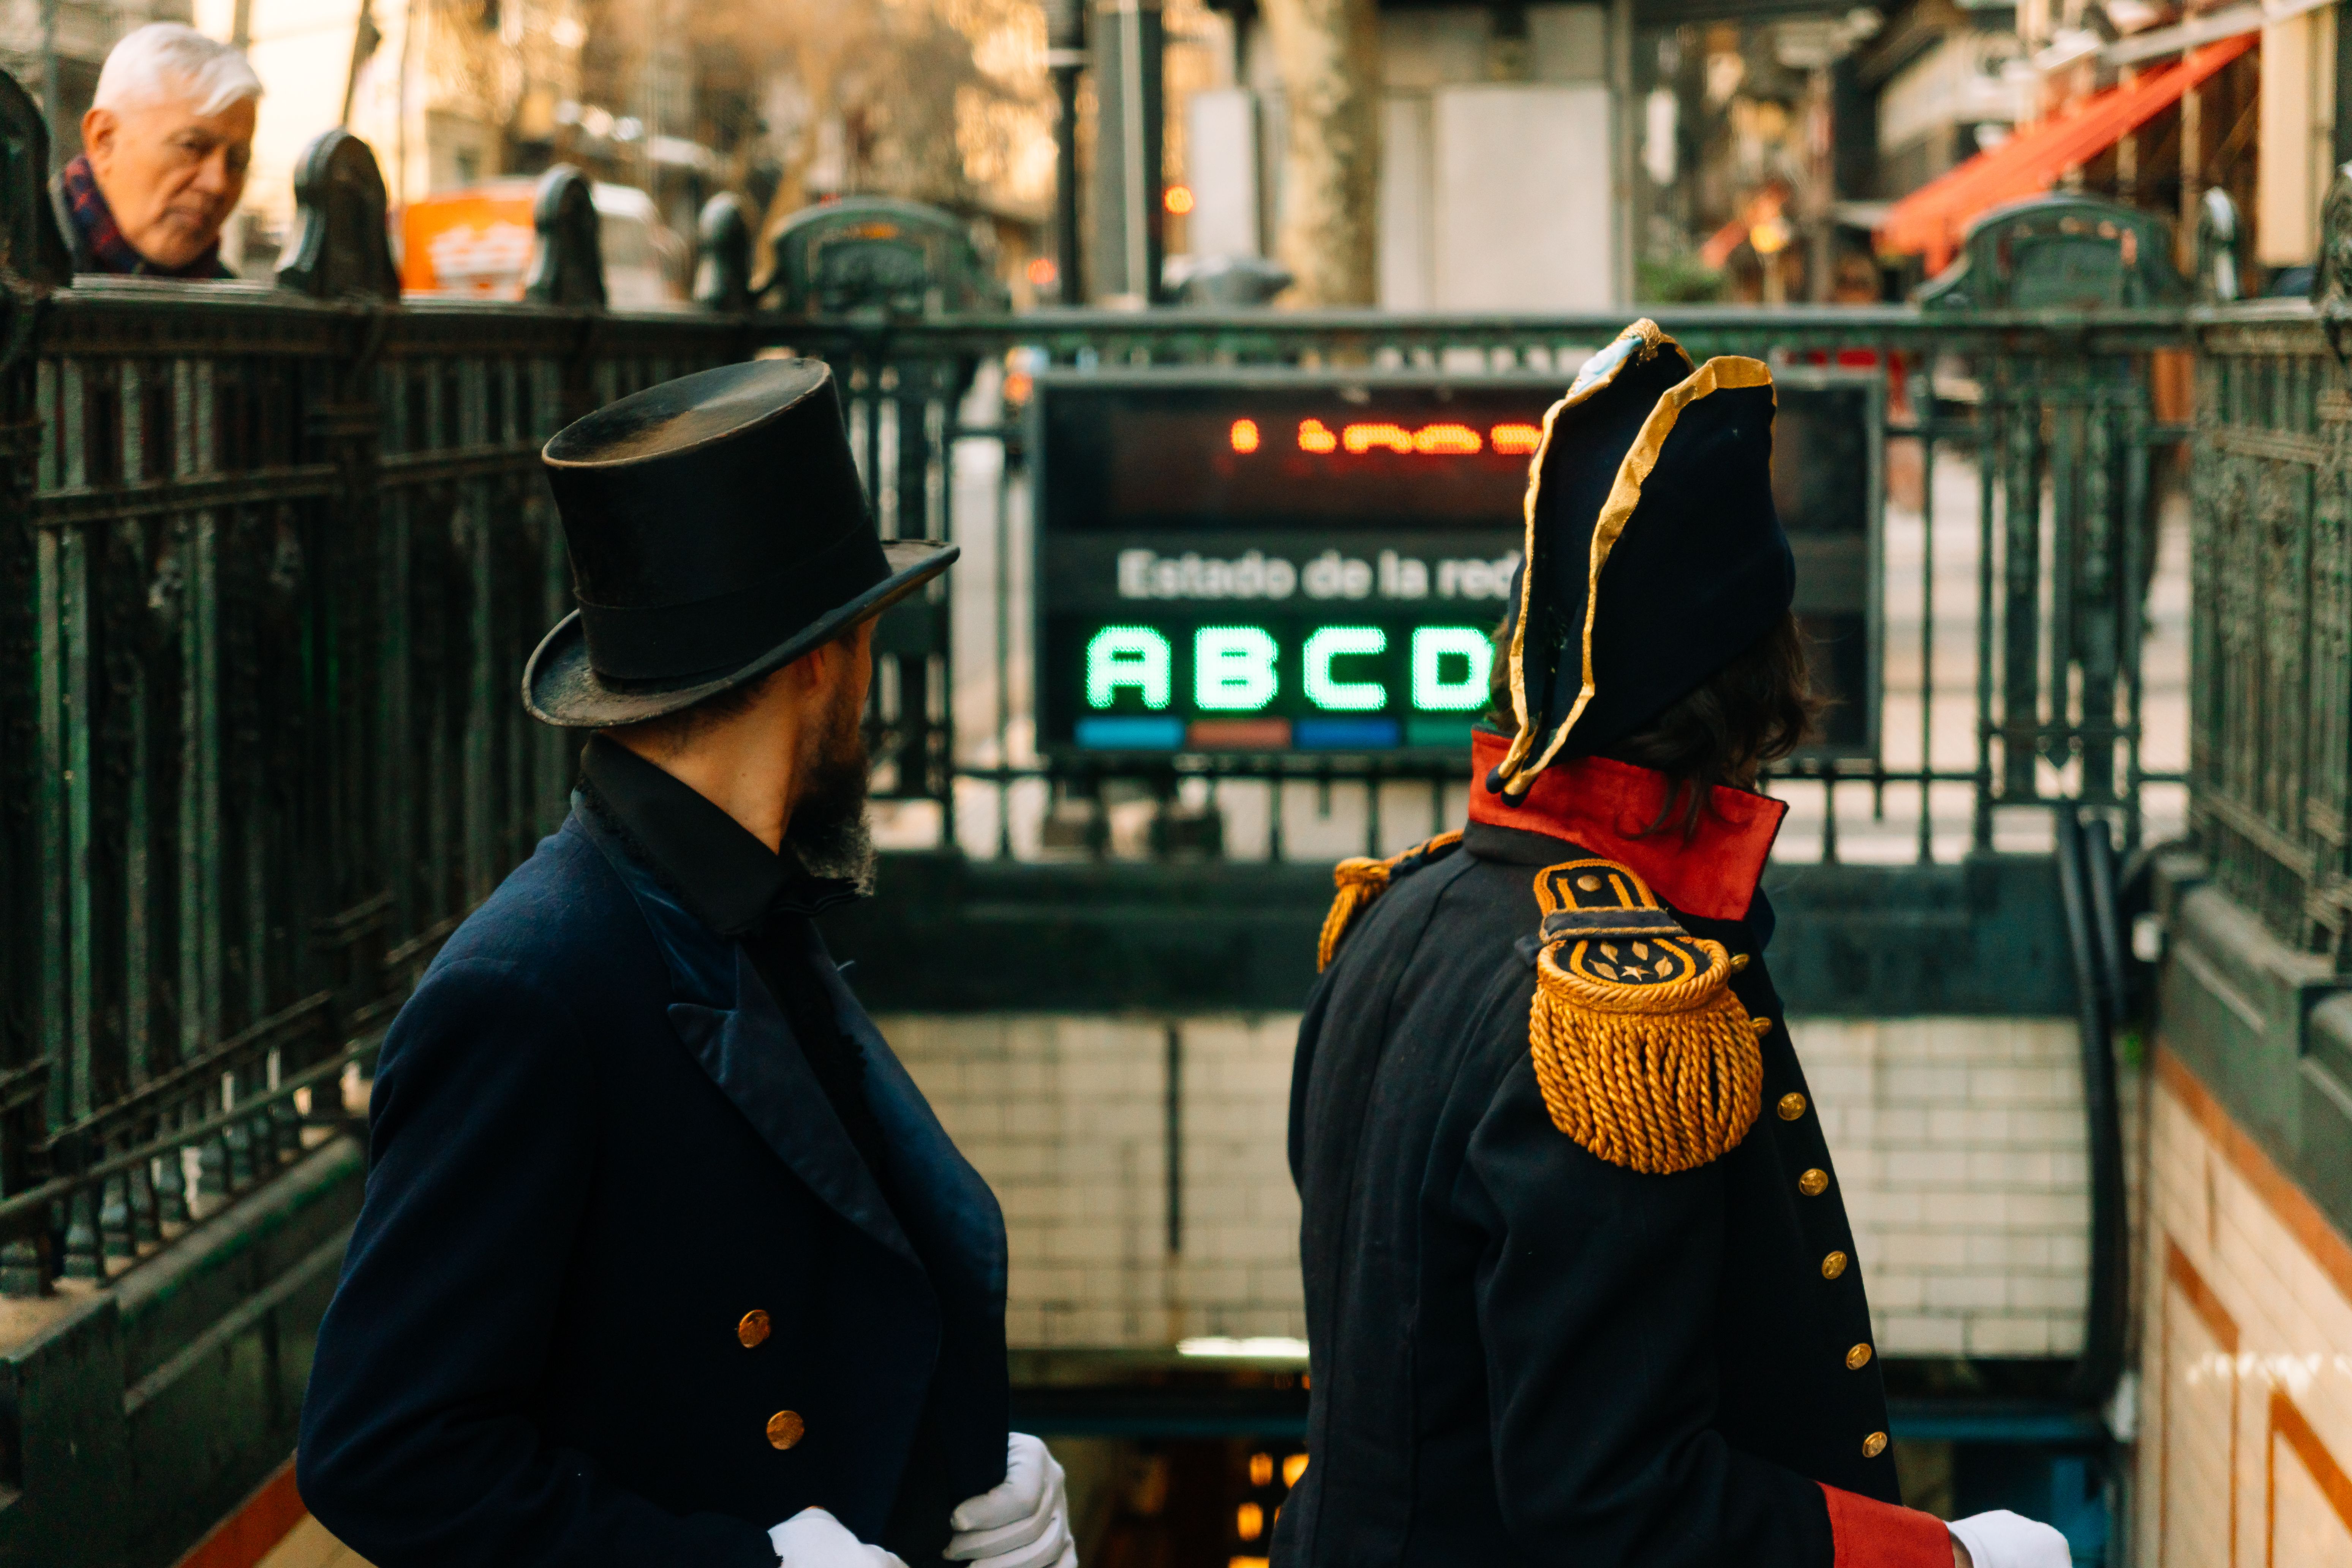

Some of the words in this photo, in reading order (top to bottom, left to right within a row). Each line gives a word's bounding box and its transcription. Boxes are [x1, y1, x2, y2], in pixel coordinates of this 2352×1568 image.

[1117, 549, 1296, 599] Estado
[1301, 549, 1372, 599] de
[1378, 549, 1429, 599] la
[1086, 626, 1171, 709] A
[1195, 626, 1279, 710] B
[1303, 626, 1387, 710] C
[1412, 626, 1494, 710] D
